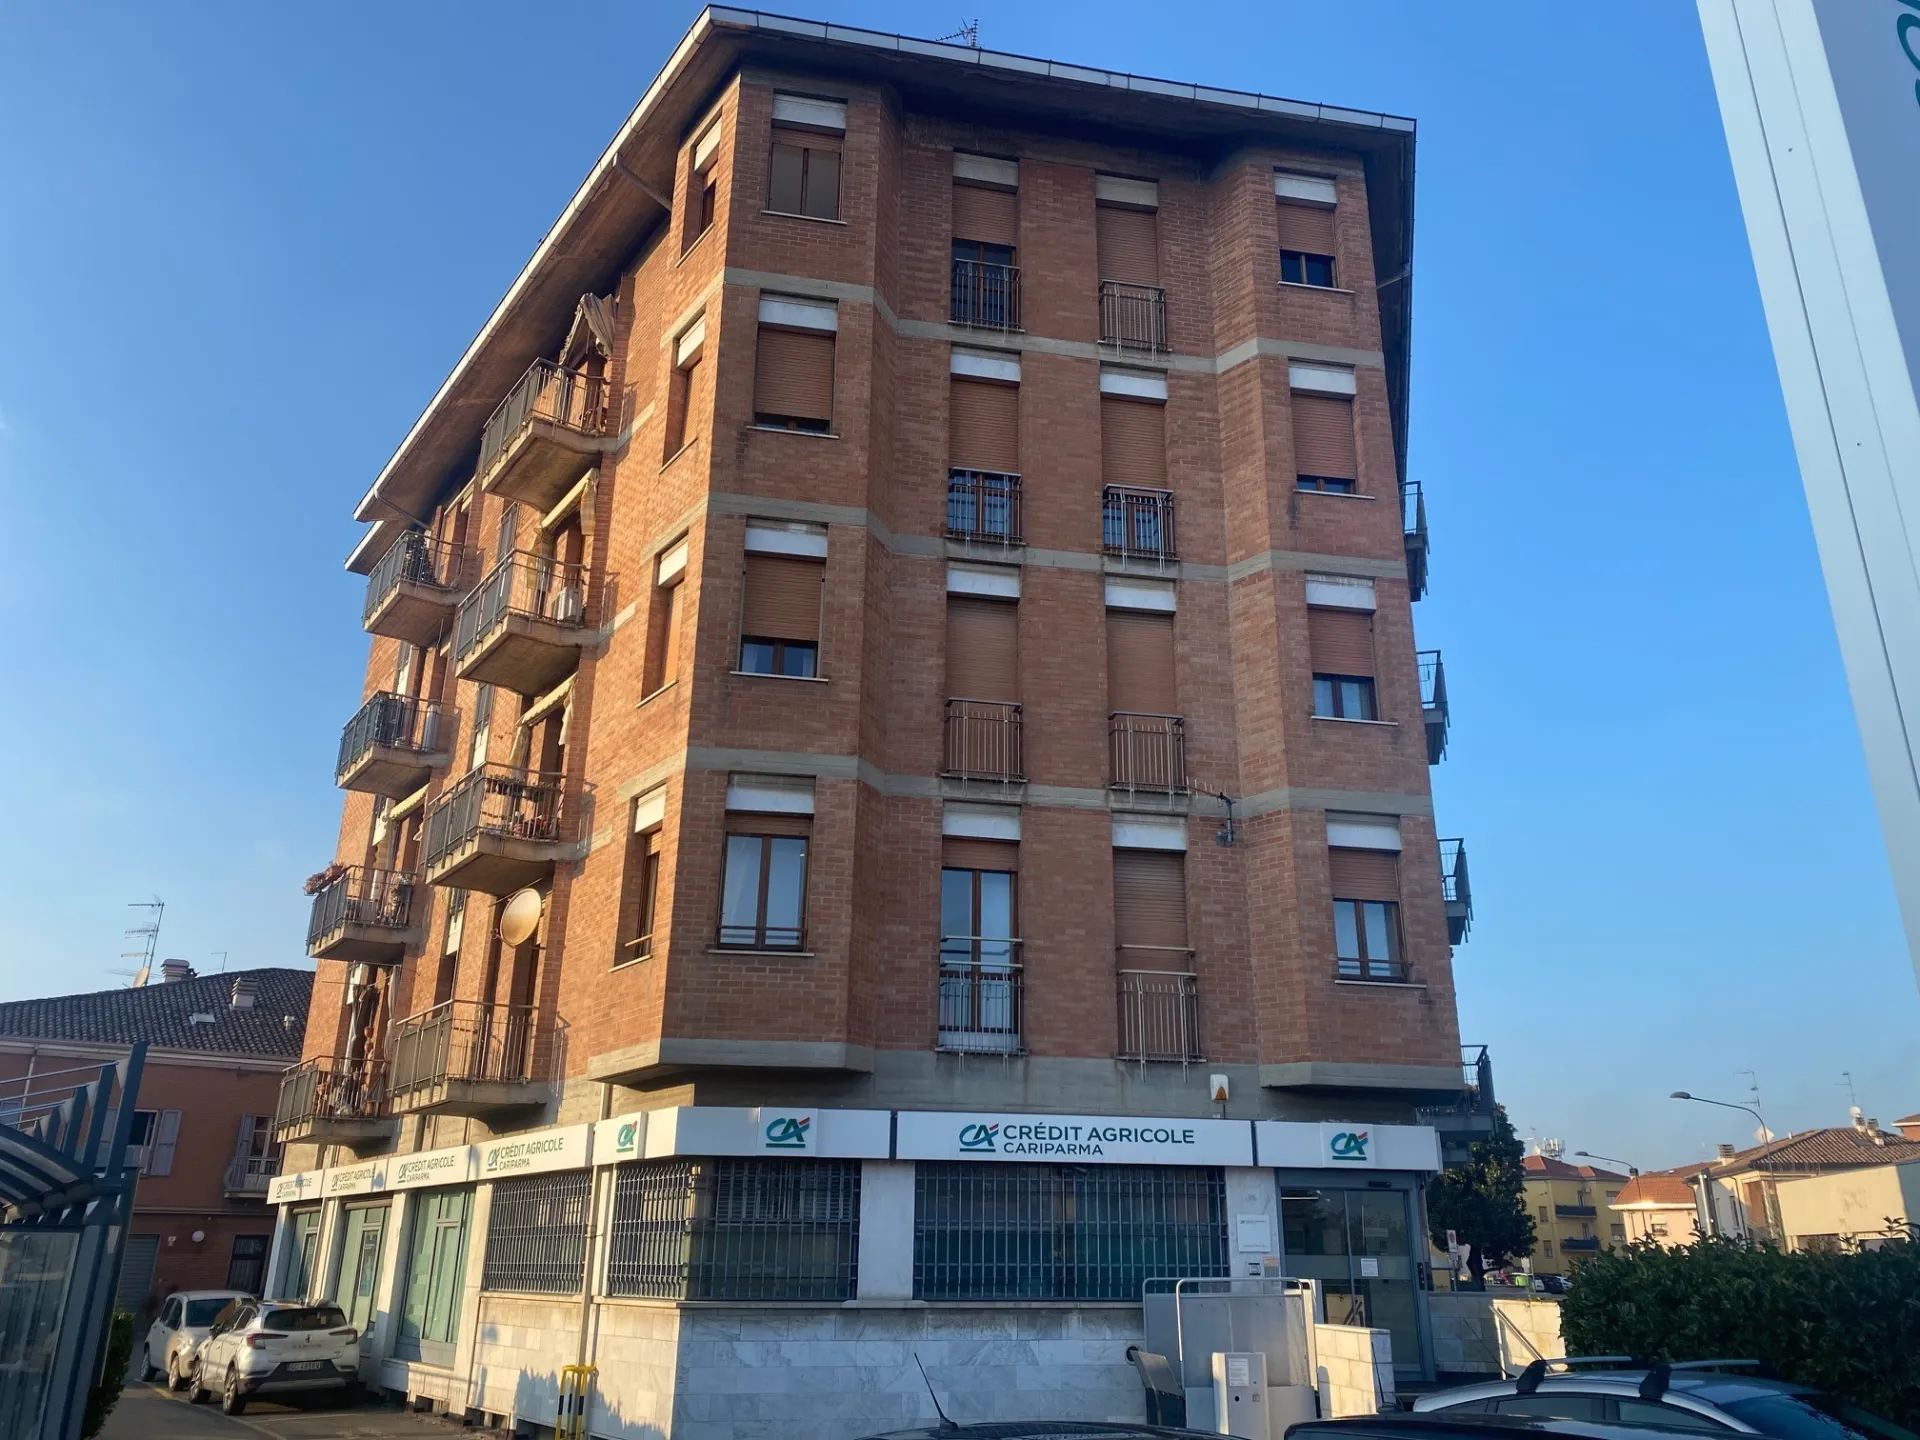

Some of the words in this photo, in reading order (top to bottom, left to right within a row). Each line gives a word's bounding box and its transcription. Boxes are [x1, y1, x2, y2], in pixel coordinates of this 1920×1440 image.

[1003, 1122, 1083, 1141] CRÉDIT
[1087, 1127, 1195, 1144] AGRICOLE
[500, 1143, 525, 1159] CRÉDIT
[526, 1137, 564, 1155] AGRICOLE
[1003, 1142, 1104, 1156] CARIPARMA
[427, 1155, 455, 1170] AGRICOLE
[499, 1158, 531, 1171] CARIPARMA
